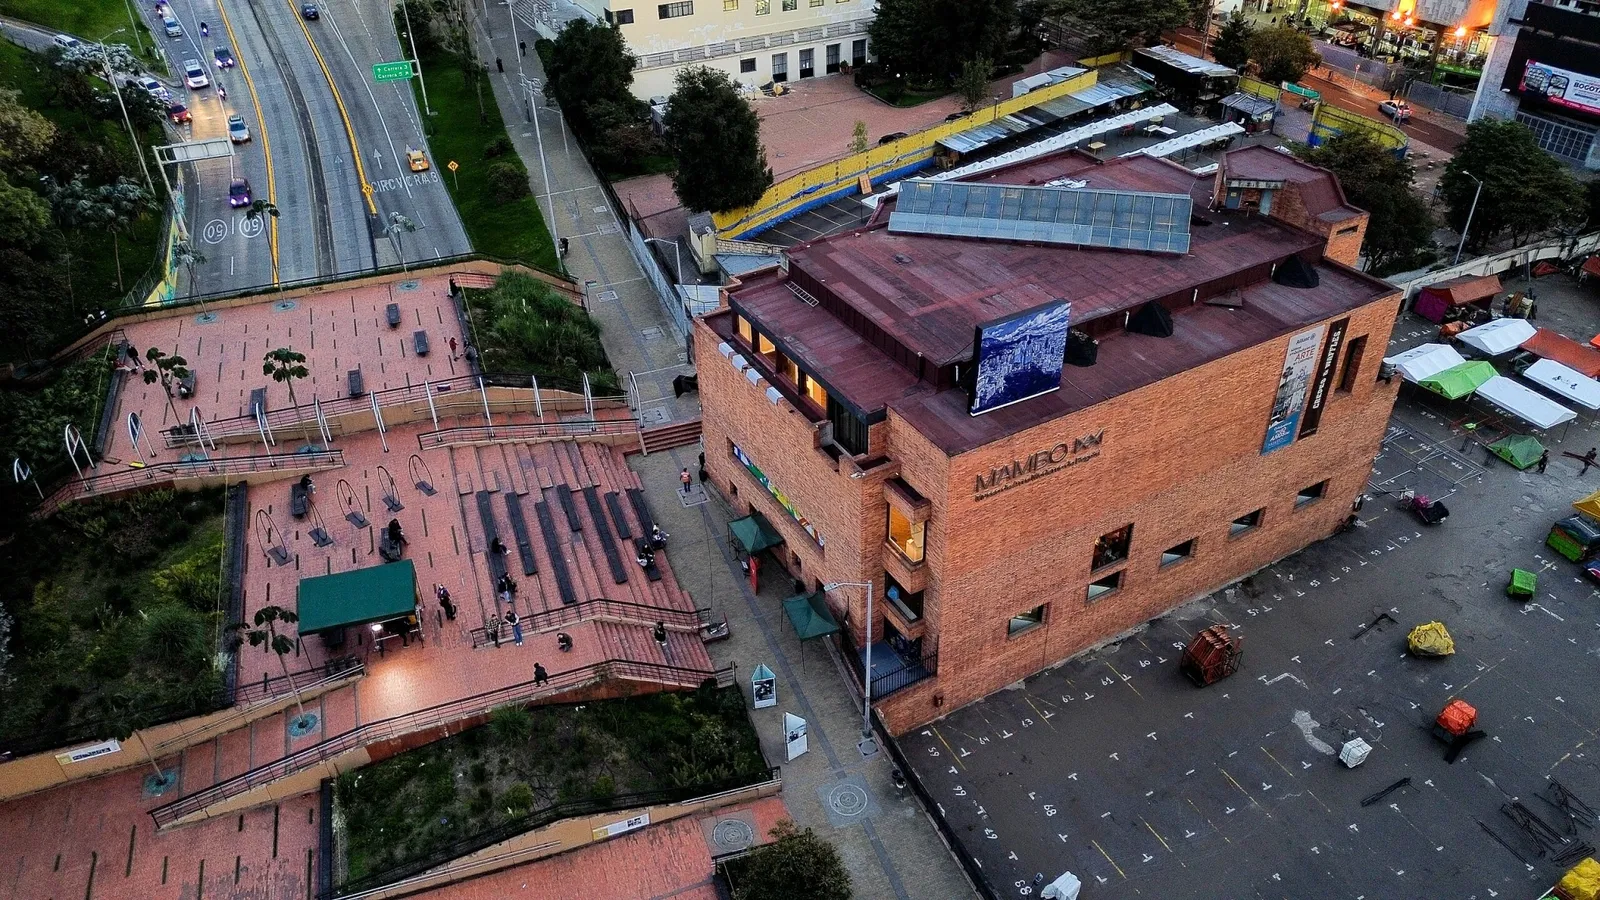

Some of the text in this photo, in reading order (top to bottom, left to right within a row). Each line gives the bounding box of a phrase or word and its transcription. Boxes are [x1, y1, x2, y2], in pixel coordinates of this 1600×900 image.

[244, 218, 258, 232] 50
[208, 224, 223, 238] 50
[1294, 350, 1314, 361] ARTE
[974, 442, 1068, 492] MAMBO
[1173, 641, 1186, 651] 59
[1139, 660, 1150, 668] 60
[1101, 676, 1114, 686] 61
[1062, 694, 1074, 703] 62
[1022, 718, 1033, 727] 63
[979, 736, 990, 745] 64
[928, 747, 939, 757] 65
